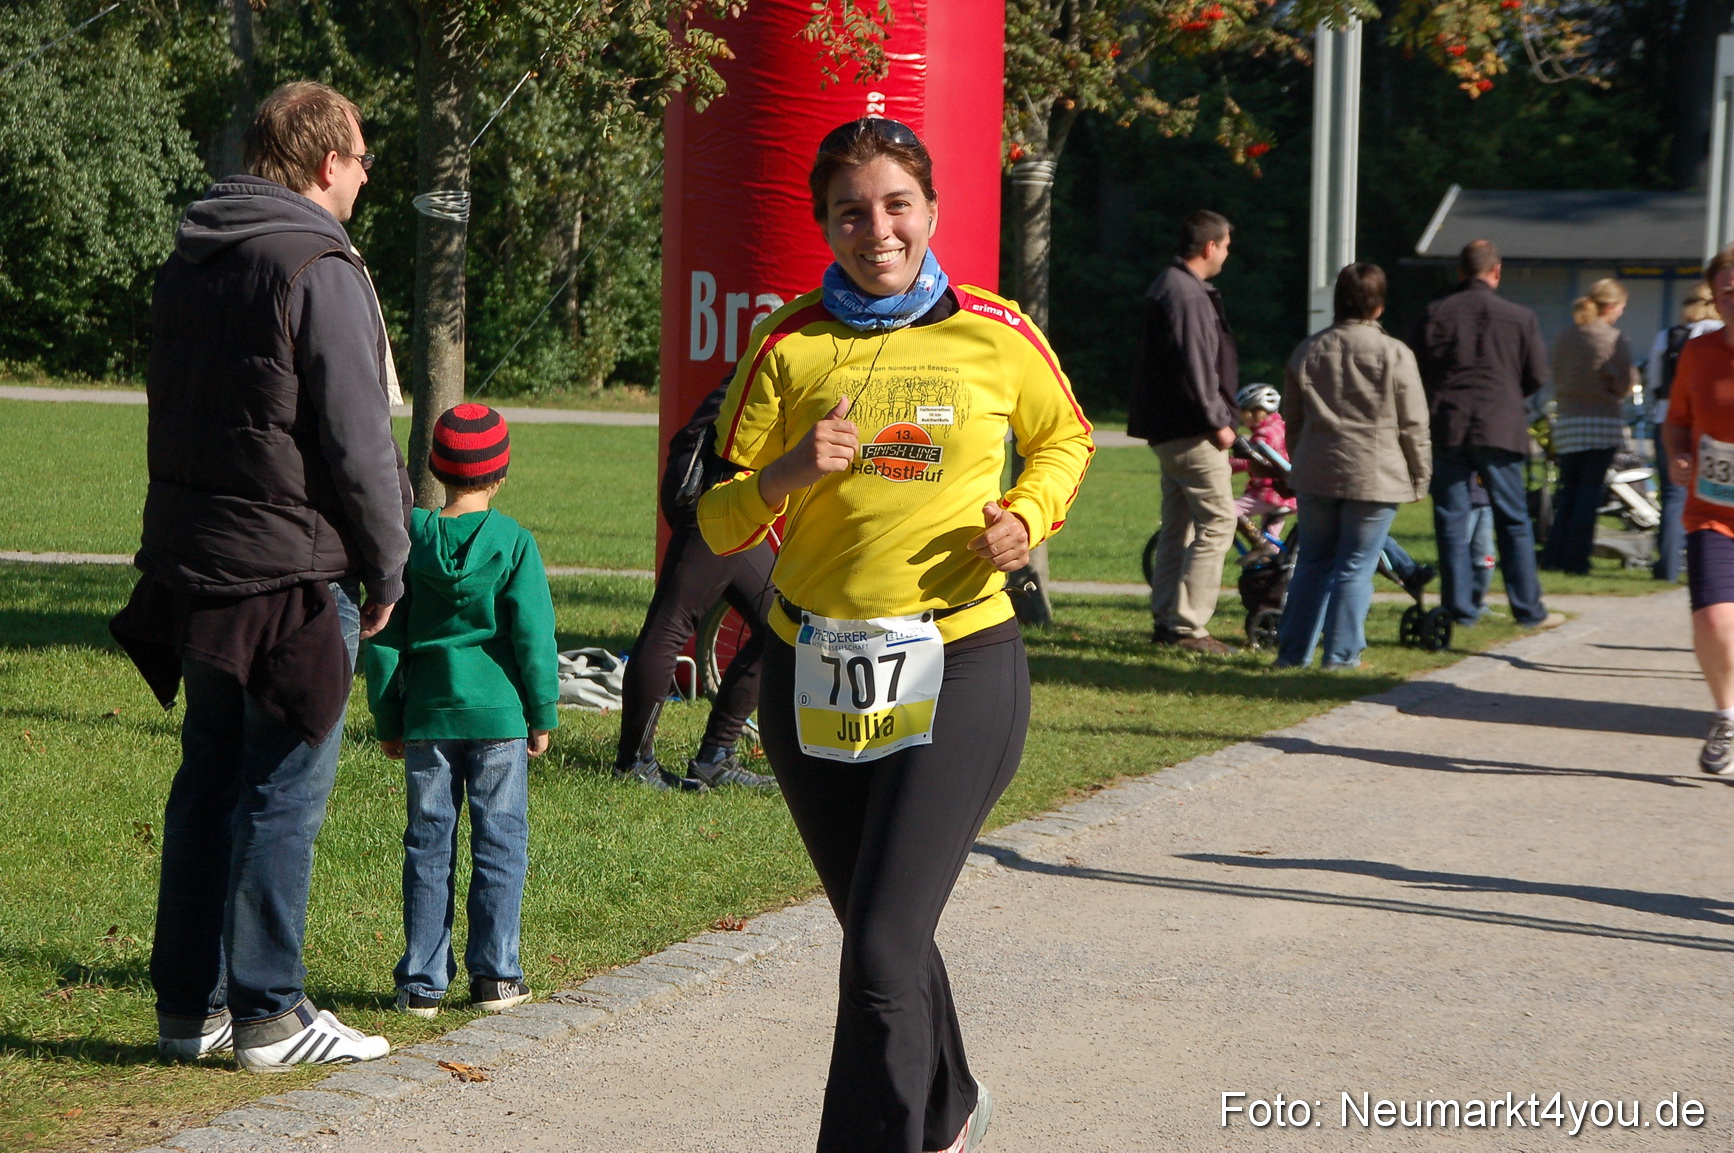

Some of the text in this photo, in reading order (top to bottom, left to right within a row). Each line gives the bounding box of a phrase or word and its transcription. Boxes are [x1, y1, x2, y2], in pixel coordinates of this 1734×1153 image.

[690, 270, 804, 363] Bra
[972, 304, 1004, 317] erima
[888, 364, 917, 372] Nürnberg
[927, 364, 960, 374] Bewegung
[895, 430, 914, 440] 13.
[865, 445, 940, 461] FINISH LINE
[850, 462, 944, 483] Herbstlauf
[820, 651, 907, 709] 707
[801, 694, 808, 705] D
[836, 713, 895, 743] Julia
